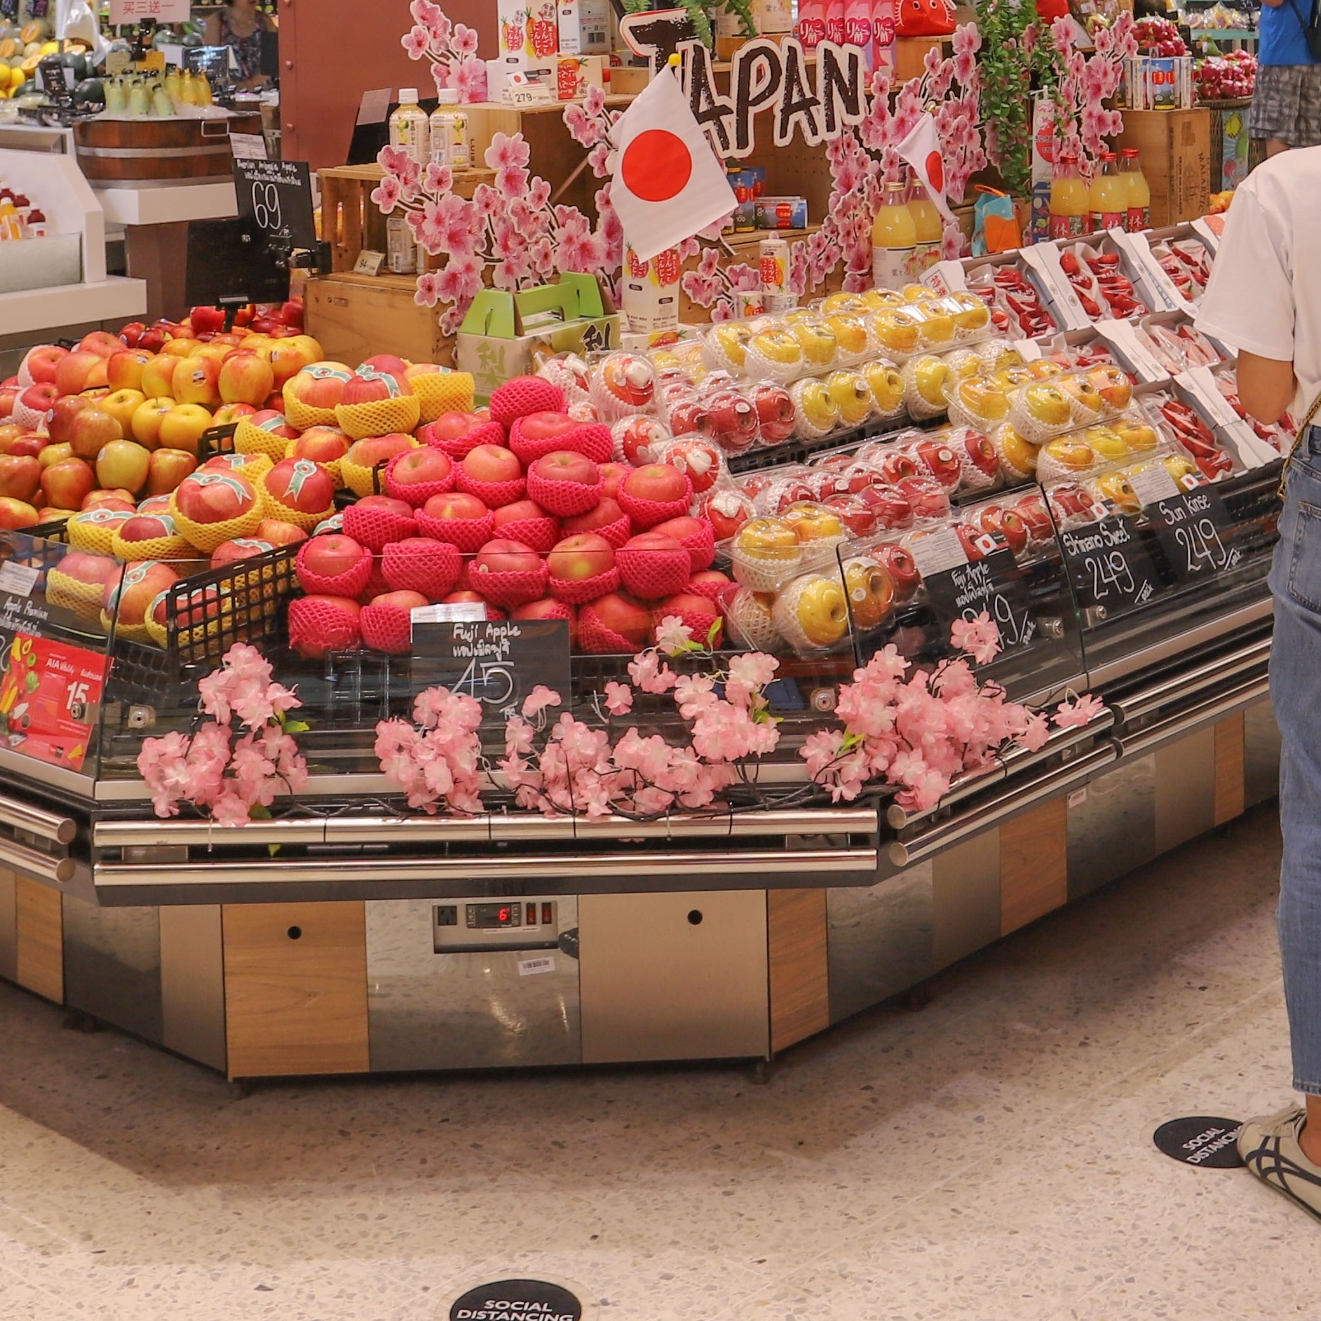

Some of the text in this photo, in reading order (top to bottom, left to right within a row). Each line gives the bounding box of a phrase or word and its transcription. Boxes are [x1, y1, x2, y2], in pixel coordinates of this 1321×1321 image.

[123, 0, 174, 16] 买三送一
[515, 92, 533, 103] 279
[251, 180, 282, 230] 69
[1159, 501, 1186, 526] Sun
[1099, 518, 1131, 548] Sweet
[1175, 518, 1228, 572] 249
[1084, 551, 1135, 601] 249
[452, 621, 522, 643] Fuji Apple
[46, 658, 60, 669] AIA
[450, 657, 515, 704] 45
[67, 681, 90, 710] 15
[1181, 1127, 1226, 1151] SOCIAL
[1186, 1125, 1243, 1164] DISTANCIN
[456, 1309, 574, 1321] DISTANCING
[484, 1299, 553, 1312] SOCIAL
